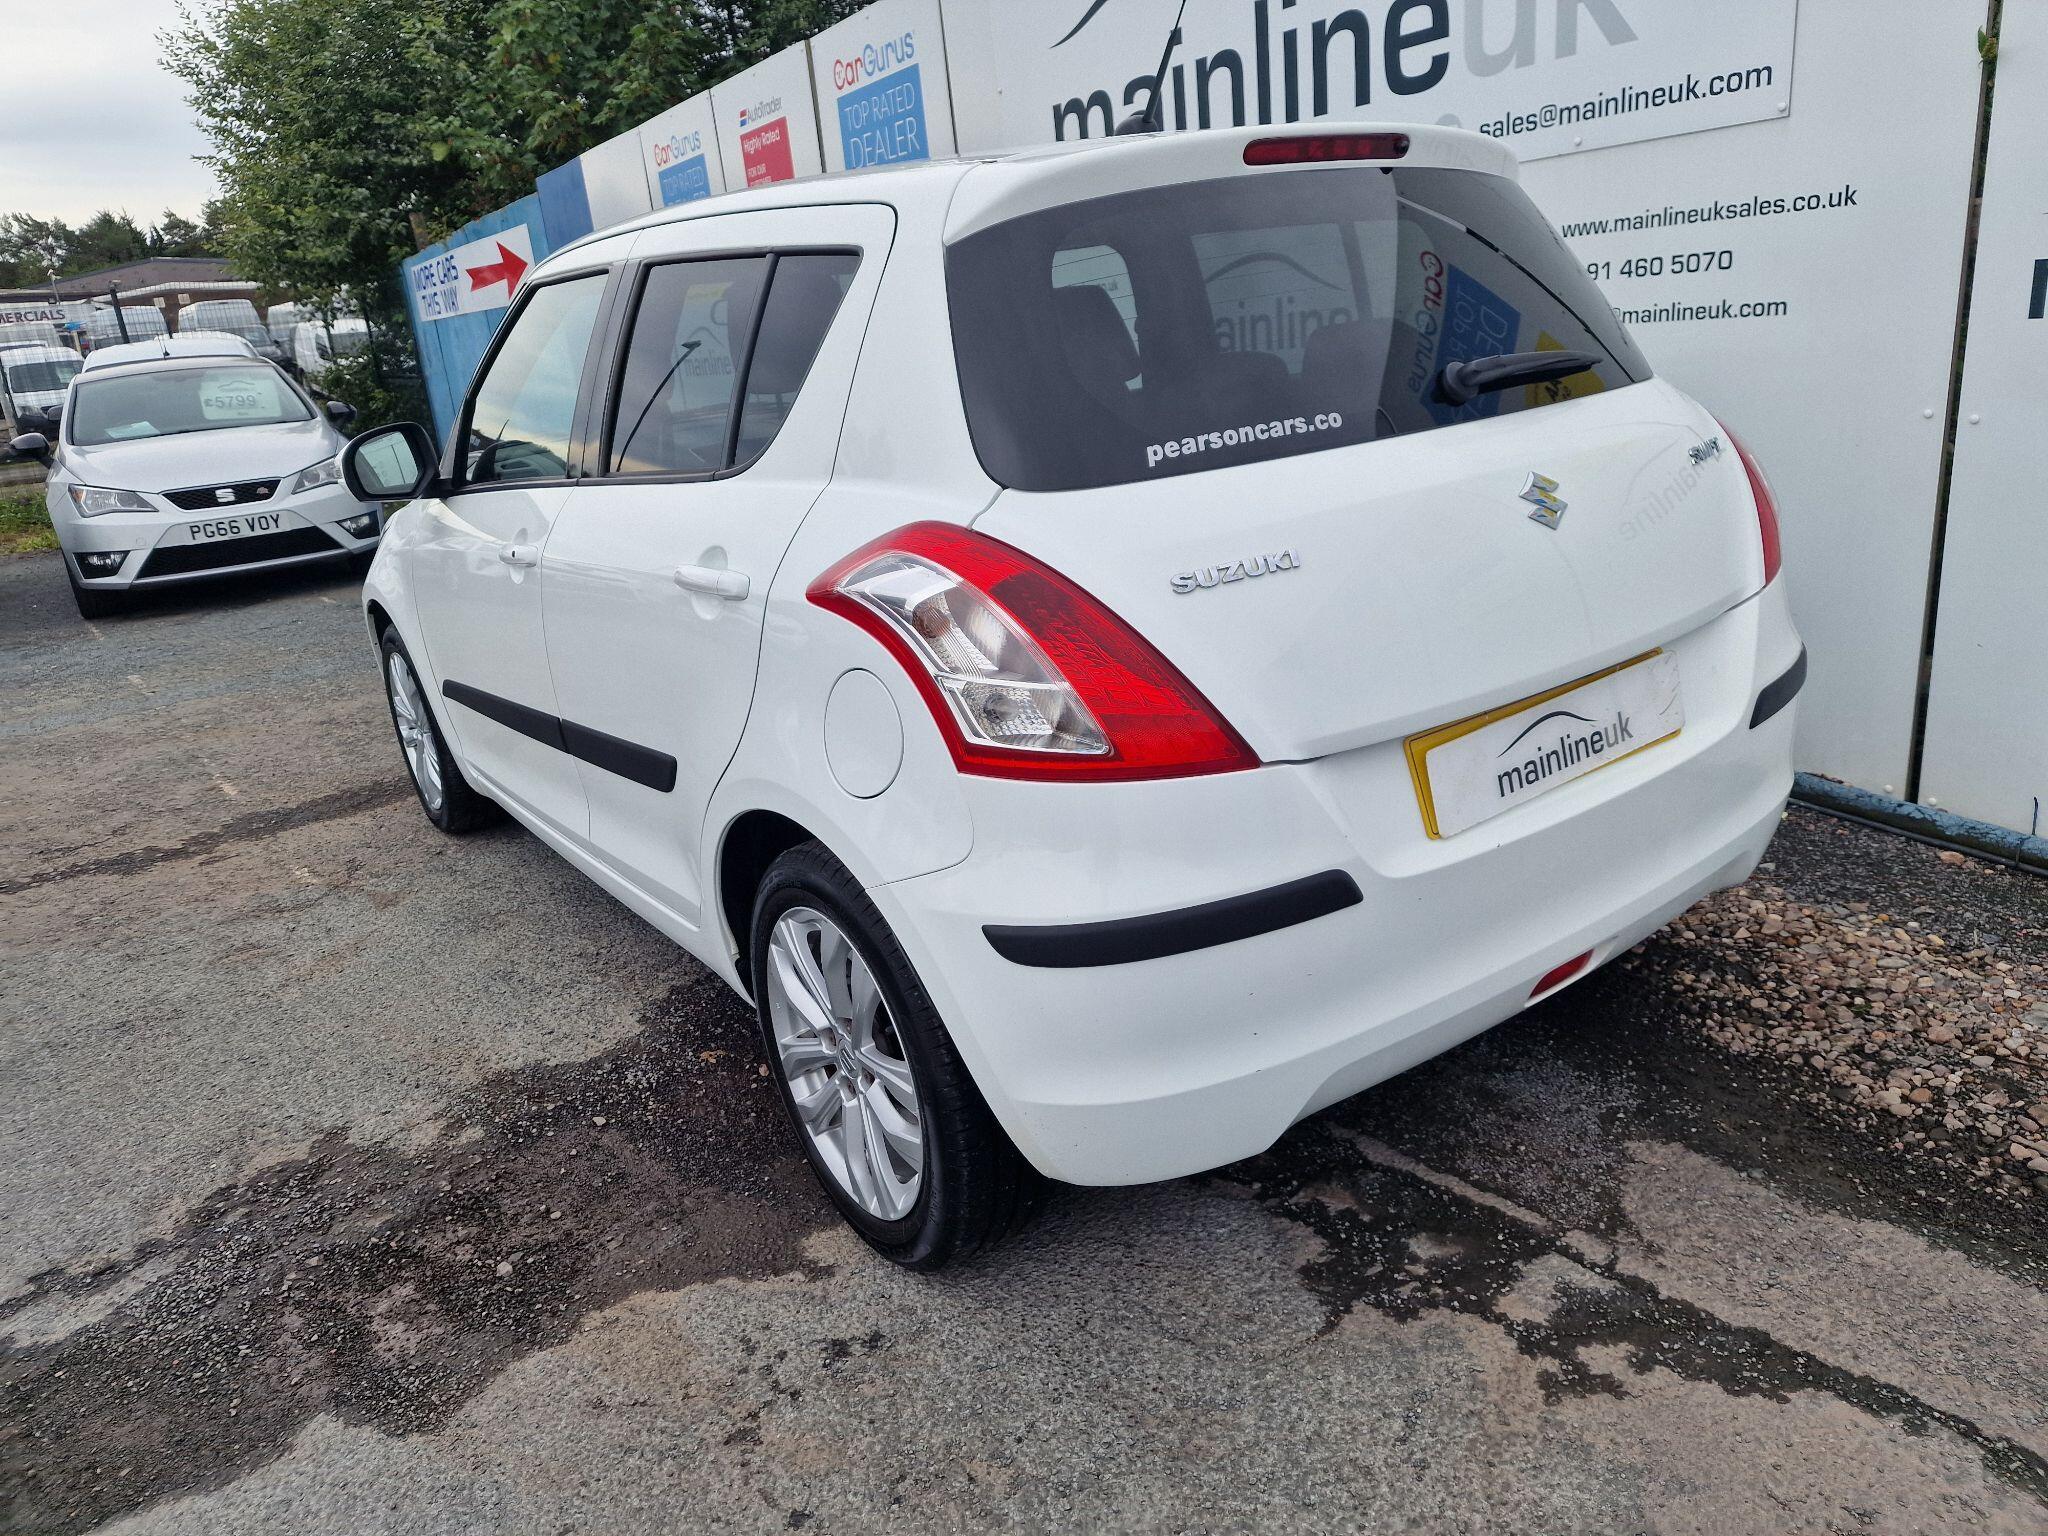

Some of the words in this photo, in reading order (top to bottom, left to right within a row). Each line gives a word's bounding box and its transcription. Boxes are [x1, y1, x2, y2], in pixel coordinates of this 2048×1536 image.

[833, 32, 915, 91] CarGurus
[747, 96, 783, 122] AutoTrader
[844, 101, 870, 131] TOP
[872, 83, 915, 121] RATED
[1480, 65, 1772, 138] sales@mainlineuk.com
[654, 131, 701, 167] CarGurus
[761, 127, 781, 146] Rated
[850, 117, 920, 168] DEALER
[1562, 185, 1858, 238] www.mainlineuksales.co.uk
[413, 264, 437, 292] MORE
[437, 254, 459, 285] CARS
[1620, 256, 1663, 278] 460
[1671, 250, 1733, 274] 5070
[422, 292, 441, 317] THIS
[440, 285, 459, 313] WAY
[1146, 412, 1343, 467] pearsoncars.co
[189, 519, 241, 541] PG66
[245, 513, 280, 533] VOY
[1170, 548, 1300, 595] SUZUKI
[1497, 711, 1634, 797] mainlineuk
